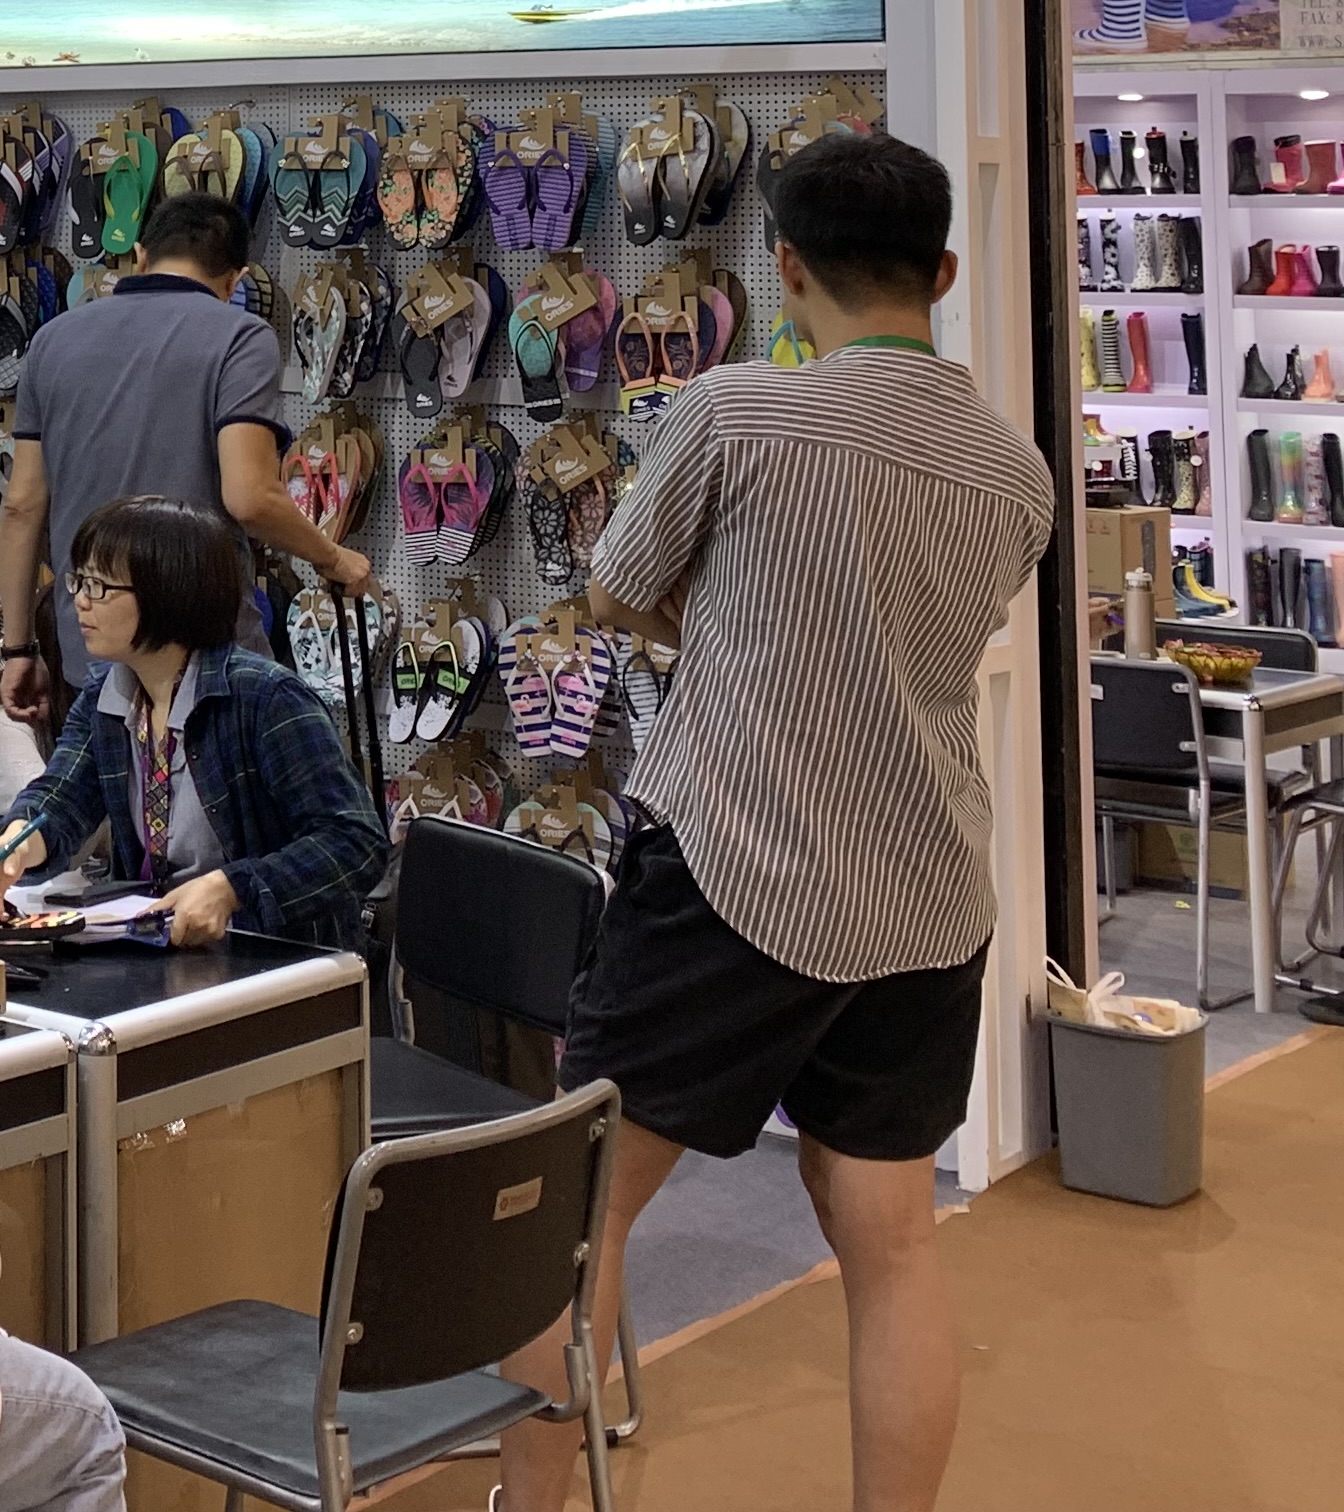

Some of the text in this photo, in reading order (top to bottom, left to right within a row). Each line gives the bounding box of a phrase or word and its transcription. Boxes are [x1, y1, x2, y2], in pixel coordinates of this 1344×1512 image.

[1300, 11, 1331, 24] FAX:
[428, 299, 454, 320] ORIES
[545, 302, 574, 322] ORIES
[559, 463, 588, 484] ORIES
